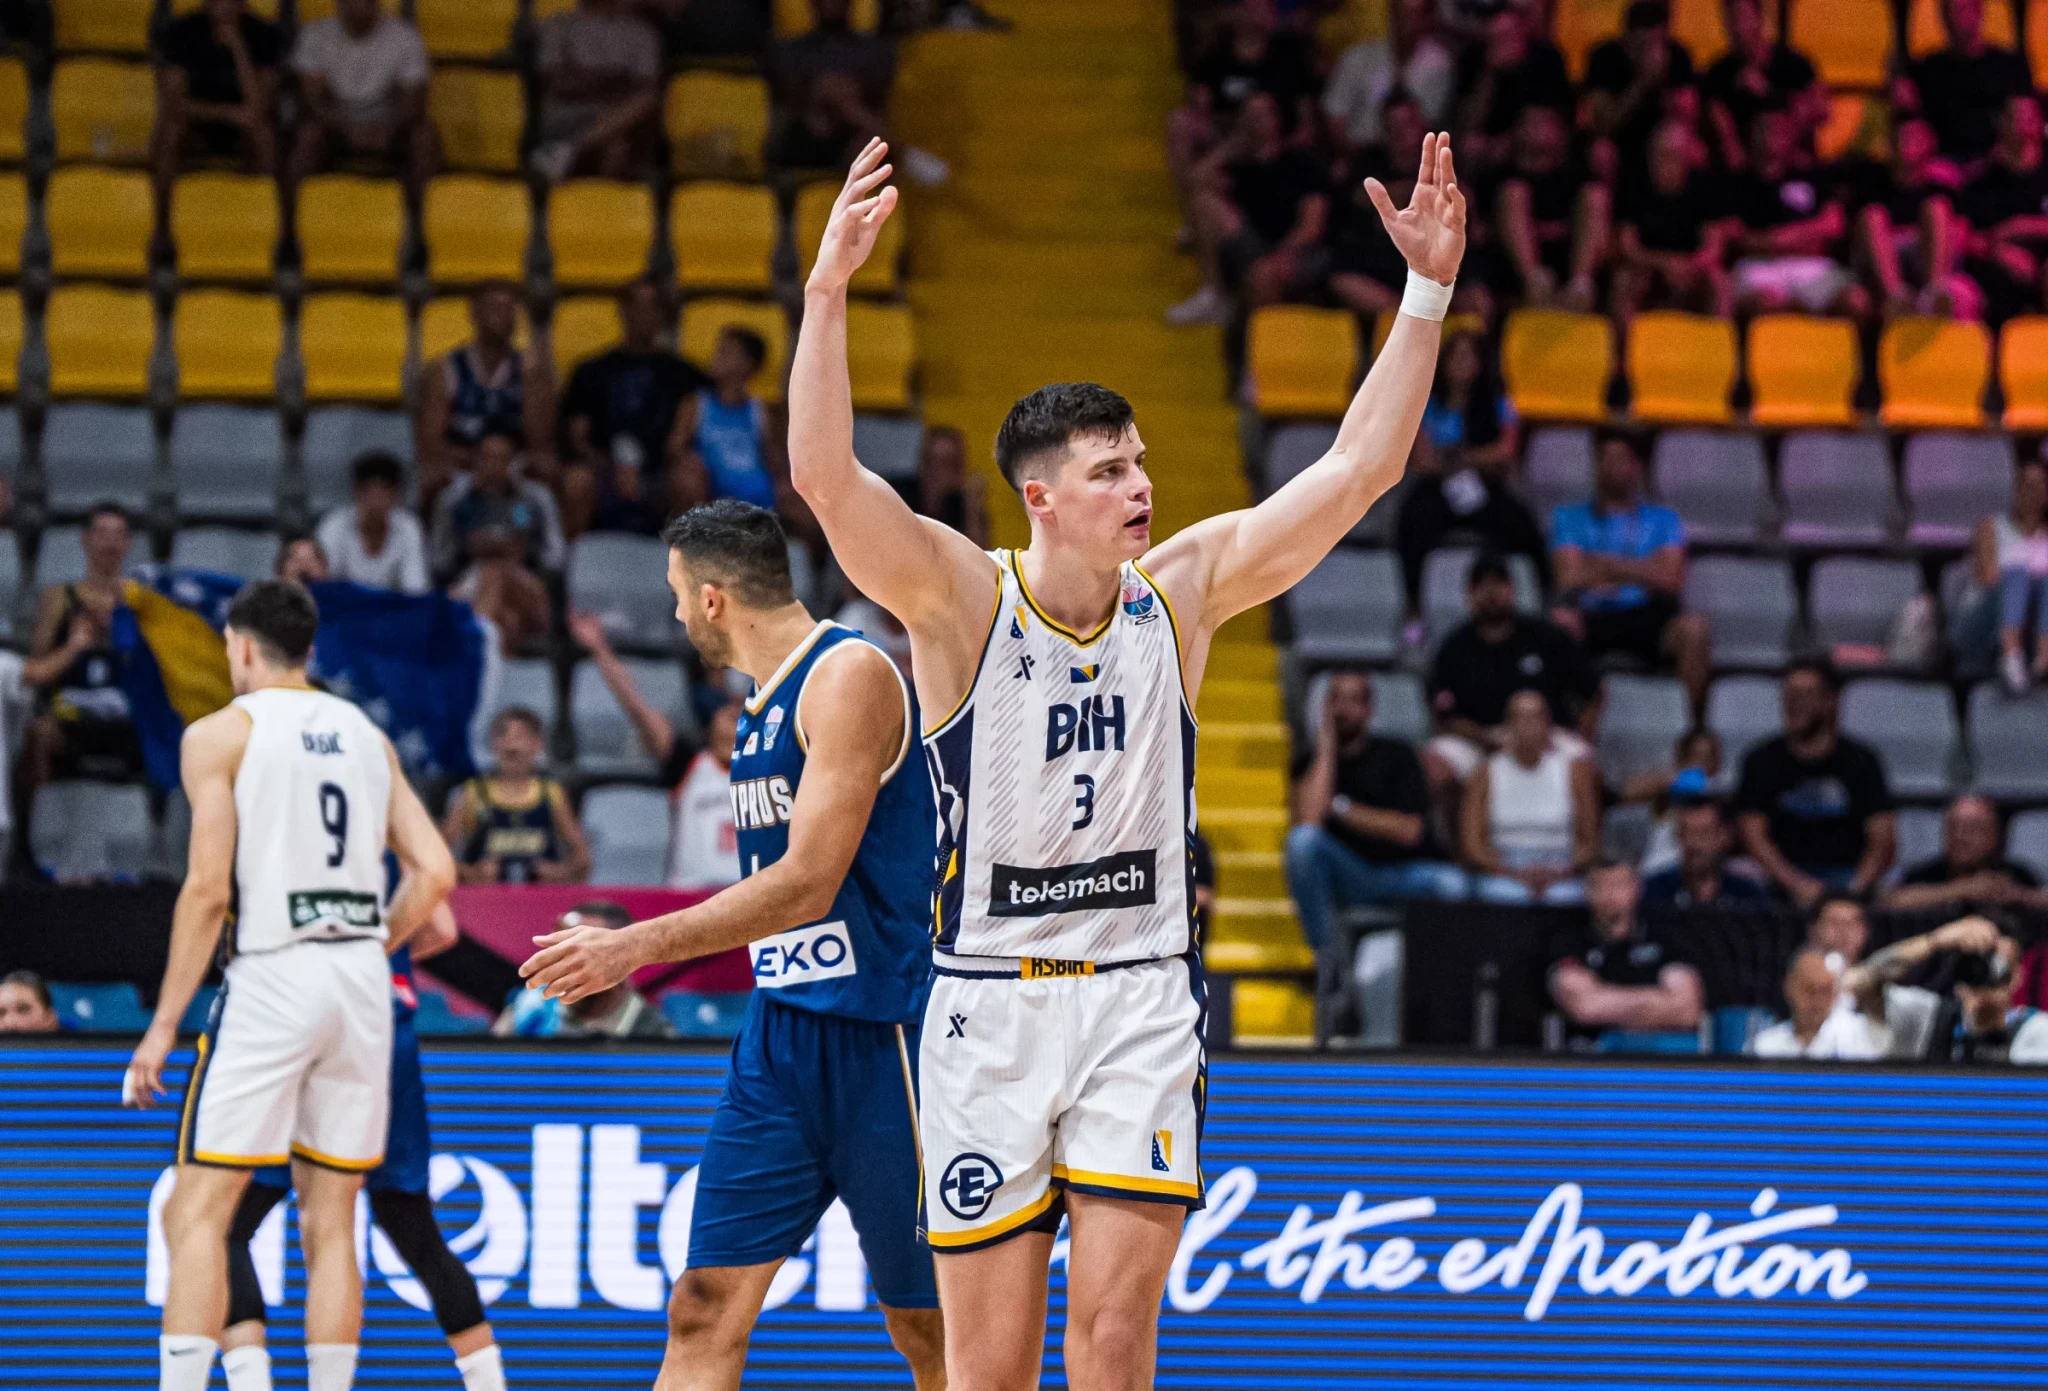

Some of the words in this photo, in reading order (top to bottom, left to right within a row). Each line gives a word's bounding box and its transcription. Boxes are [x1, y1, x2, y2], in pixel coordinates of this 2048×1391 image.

[1045, 694, 1126, 762] BIH
[319, 781, 348, 868] 9
[729, 775, 795, 830] YPRUS
[1072, 774, 1095, 831] 3
[1009, 864, 1145, 905] telemach
[754, 933, 847, 978] EKO
[1240, 1189, 1437, 1305] the
